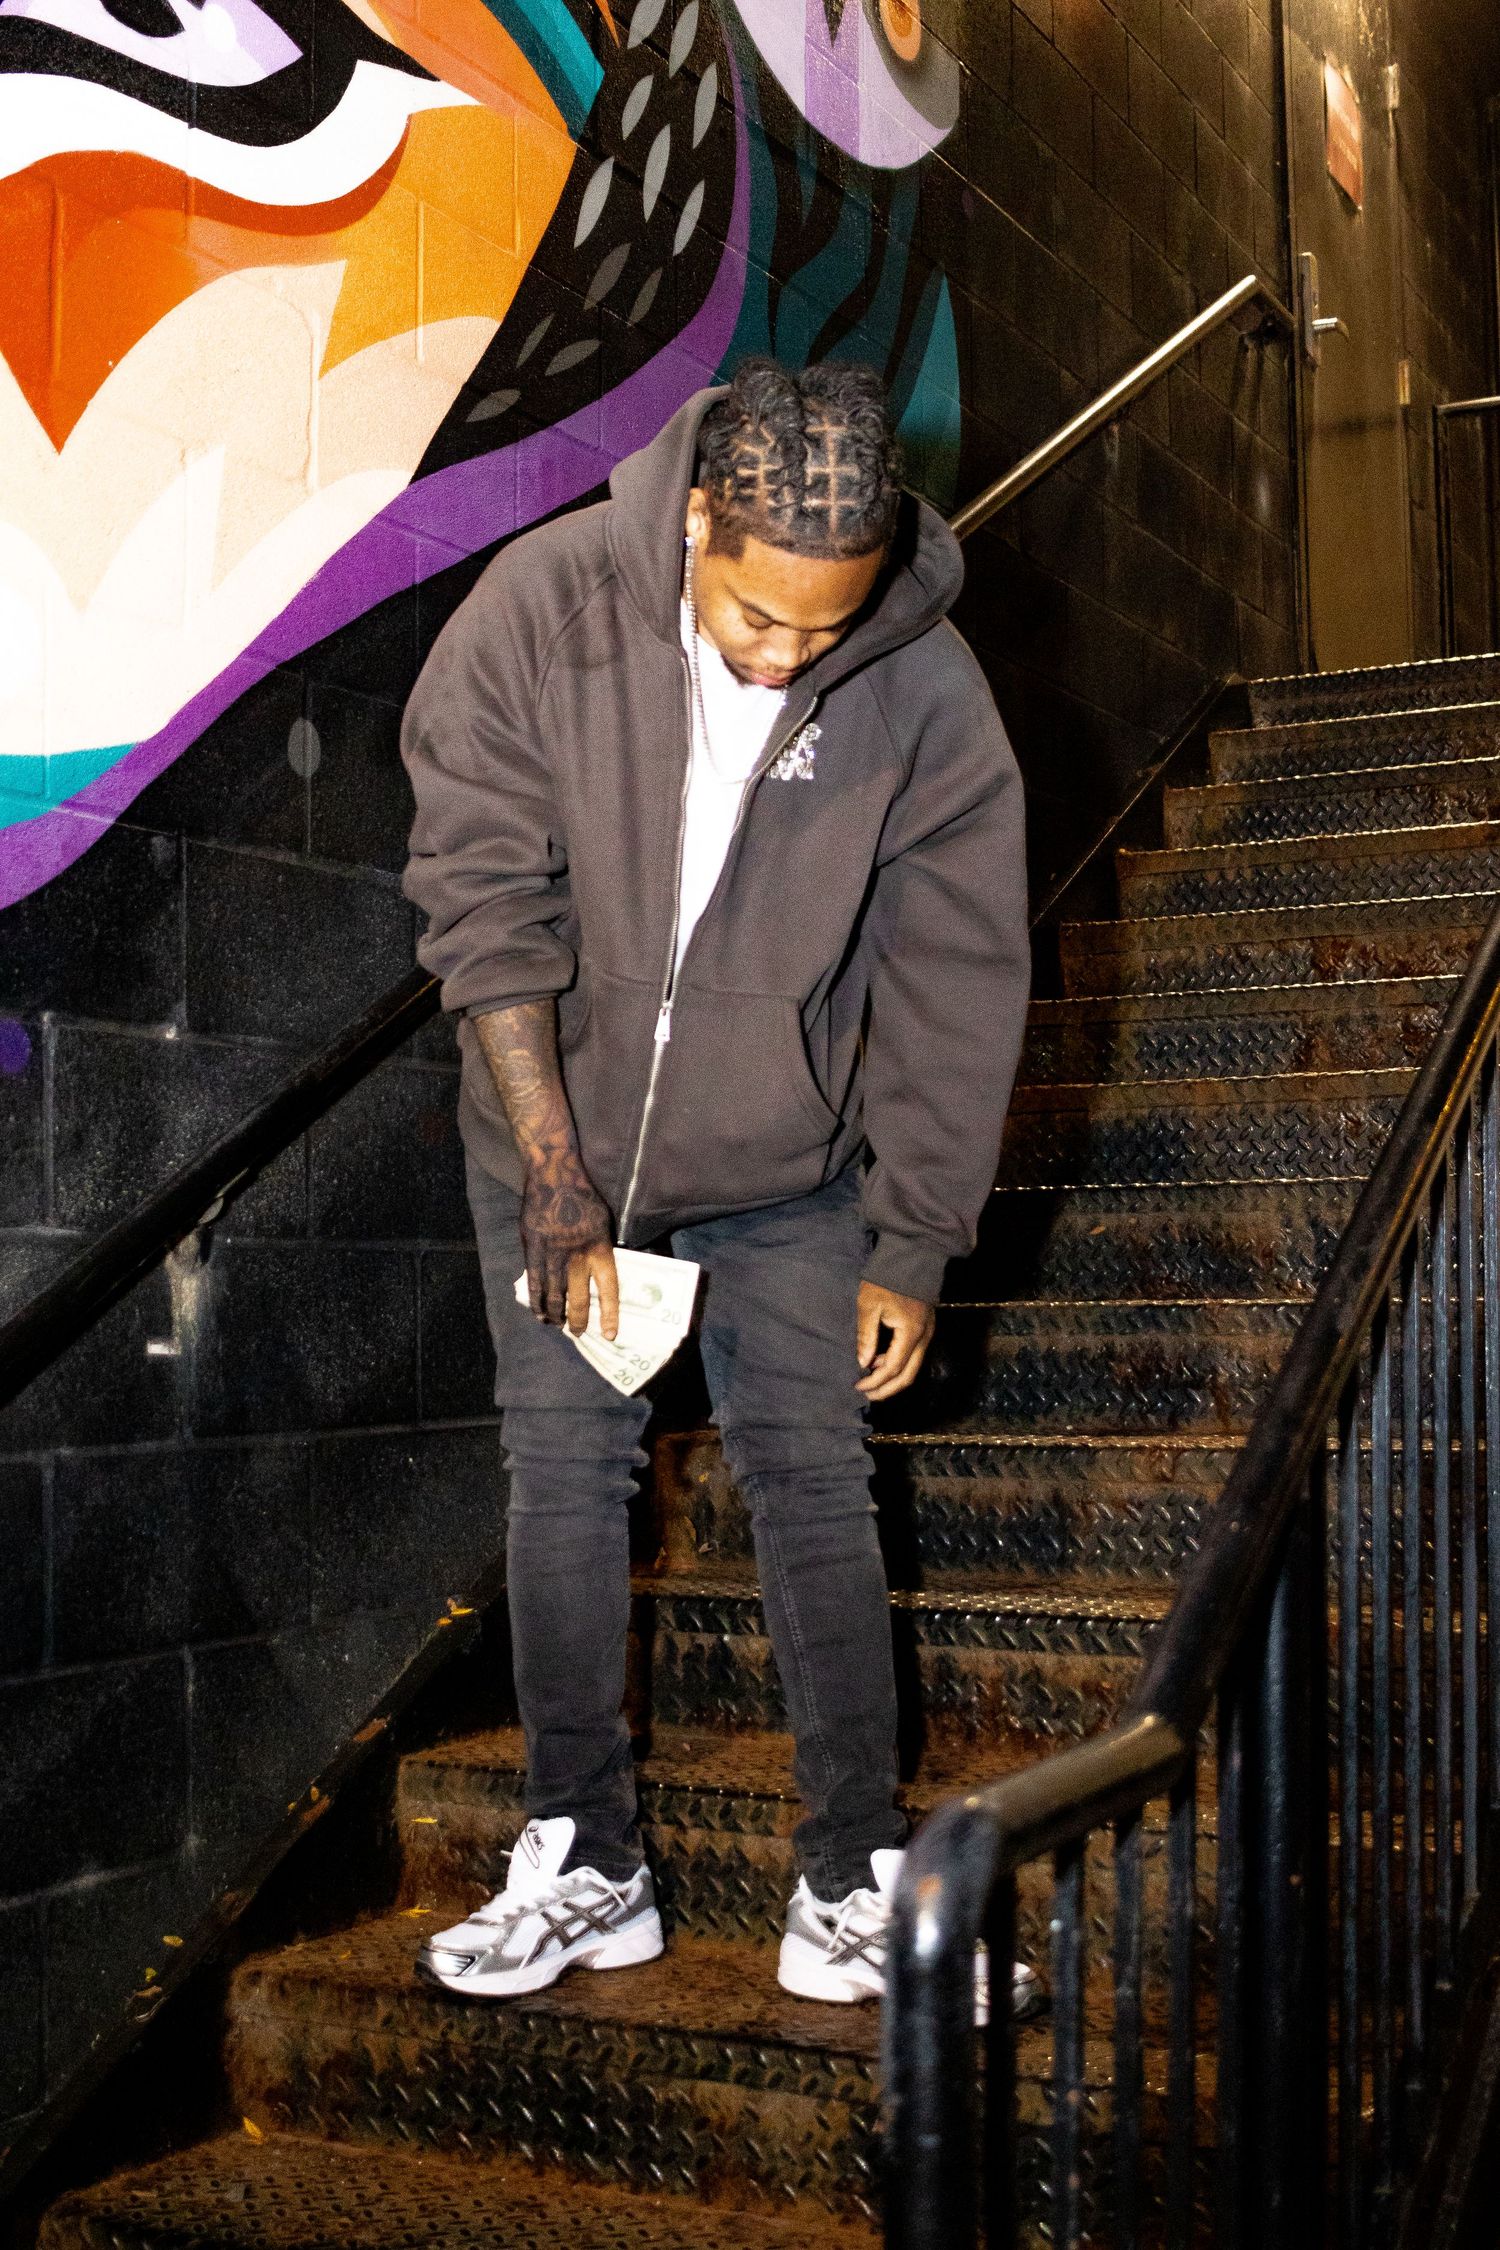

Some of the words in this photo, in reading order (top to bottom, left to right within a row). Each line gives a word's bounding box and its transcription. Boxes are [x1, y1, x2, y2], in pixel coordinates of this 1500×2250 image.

[661, 1308, 682, 1326] 20
[628, 1353, 651, 1372] 20
[613, 1368, 635, 1387] 20
